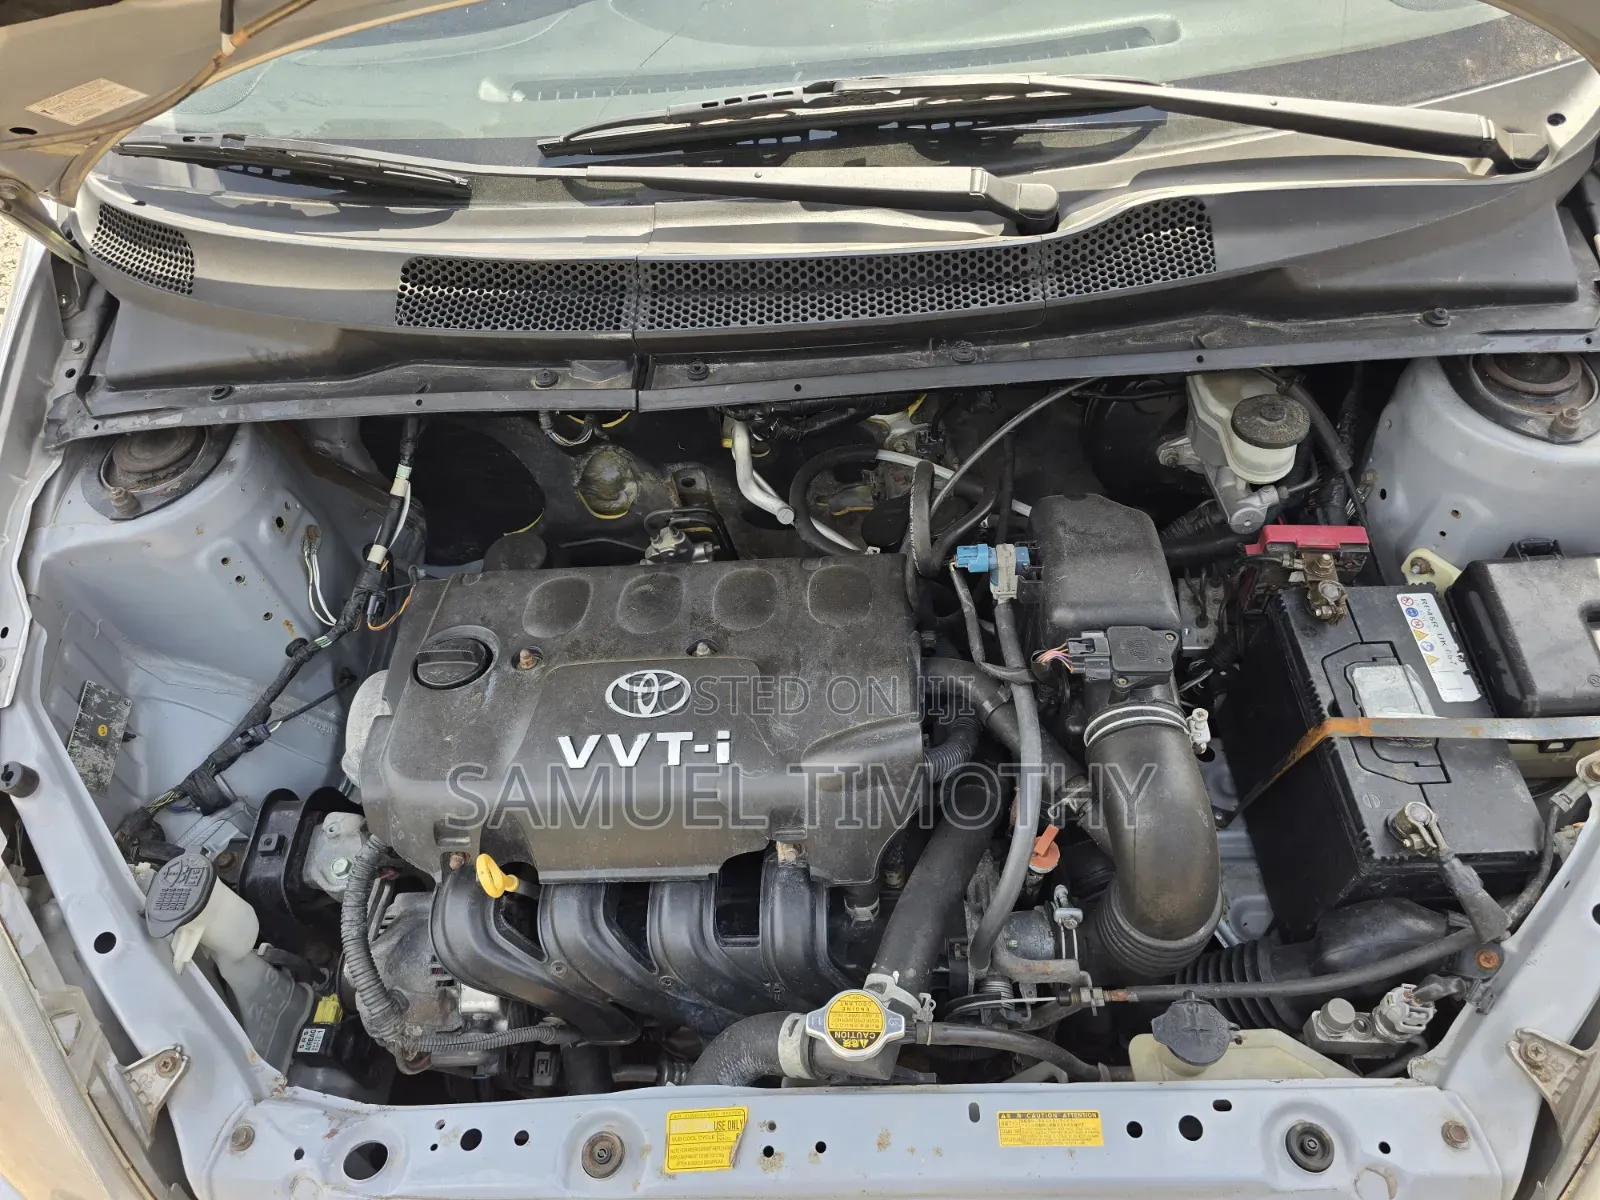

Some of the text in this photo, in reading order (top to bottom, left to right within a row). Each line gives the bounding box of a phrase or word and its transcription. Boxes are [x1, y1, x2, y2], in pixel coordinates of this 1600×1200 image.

[557, 730, 731, 768] VVT-i
[834, 1031, 876, 1039] CAUTION
[713, 1120, 726, 1131] USE
[727, 1119, 744, 1130] ONLY
